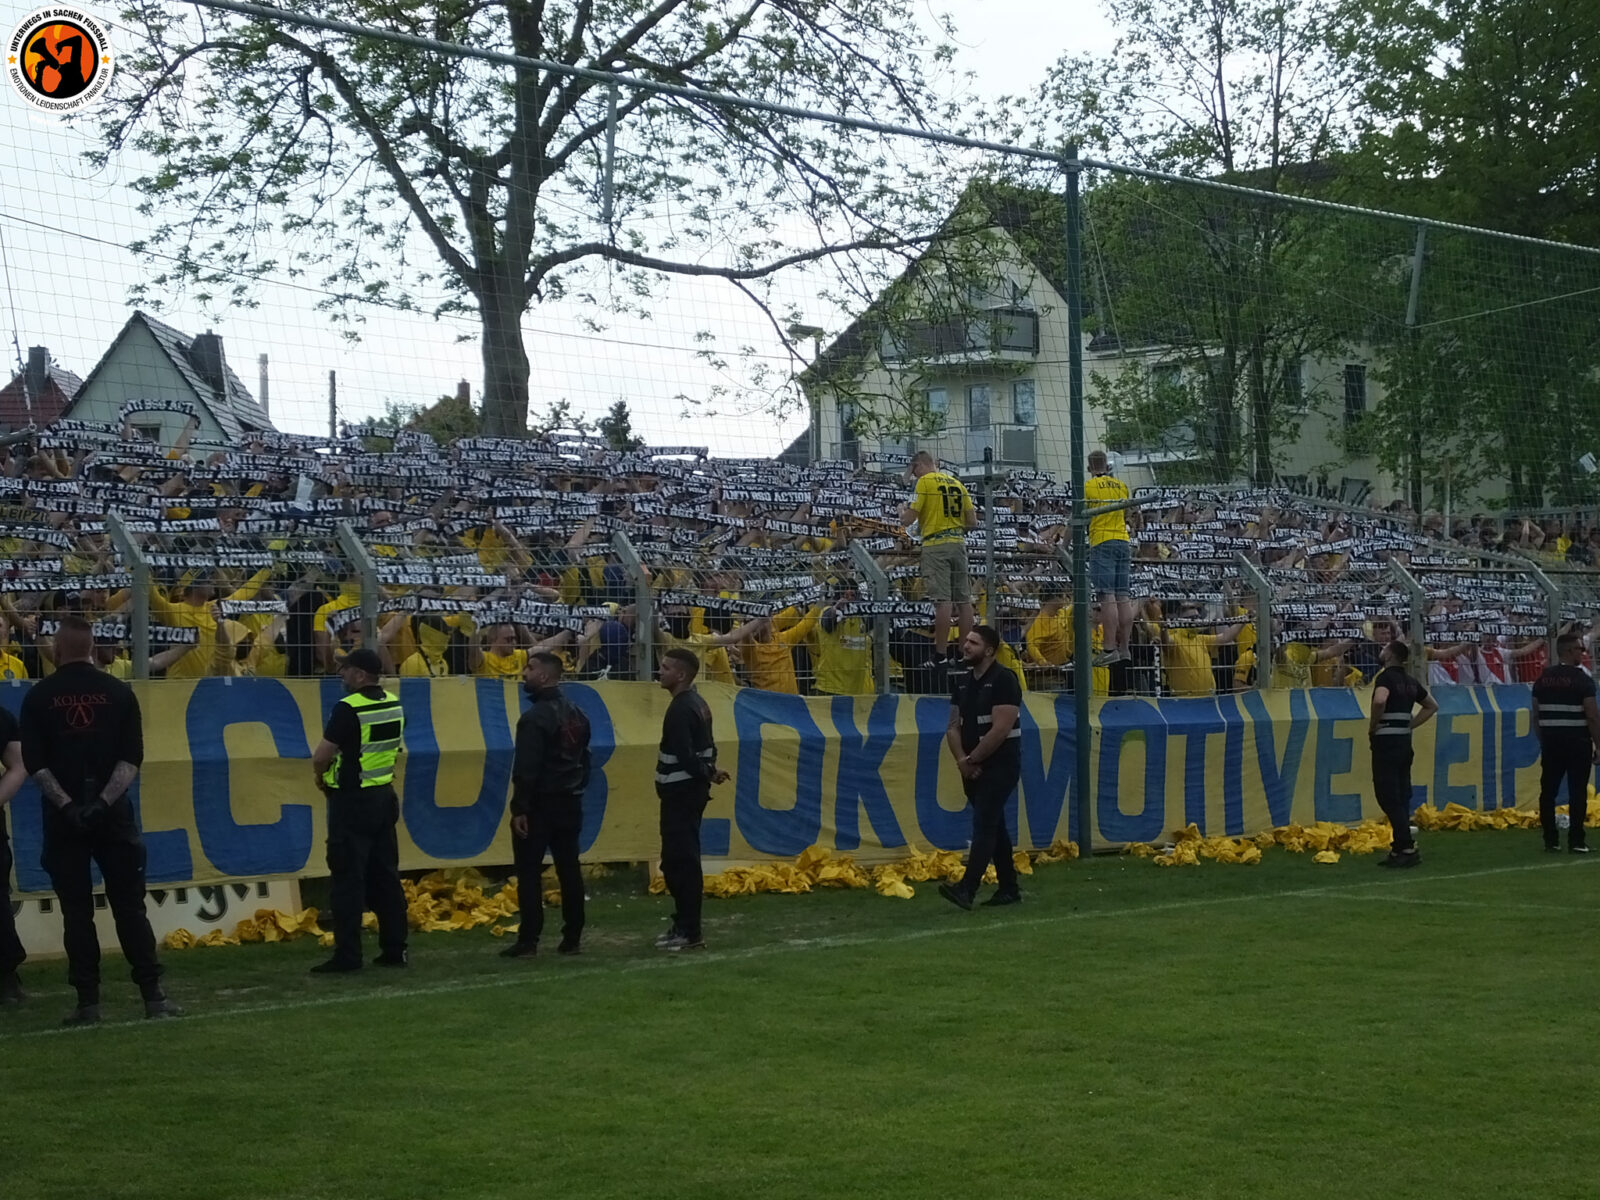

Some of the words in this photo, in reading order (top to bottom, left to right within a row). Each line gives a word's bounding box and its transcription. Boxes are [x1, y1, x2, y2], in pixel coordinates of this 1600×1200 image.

[937, 484, 962, 518] 13
[76, 500, 104, 514] BSG
[107, 503, 161, 518] ACTION
[161, 518, 221, 532] ACTION
[219, 553, 273, 566] ACTION
[439, 575, 506, 586] ACTION
[420, 599, 458, 610] ANTI
[92, 622, 126, 638] BSG
[53, 694, 108, 707] KOLOSS
